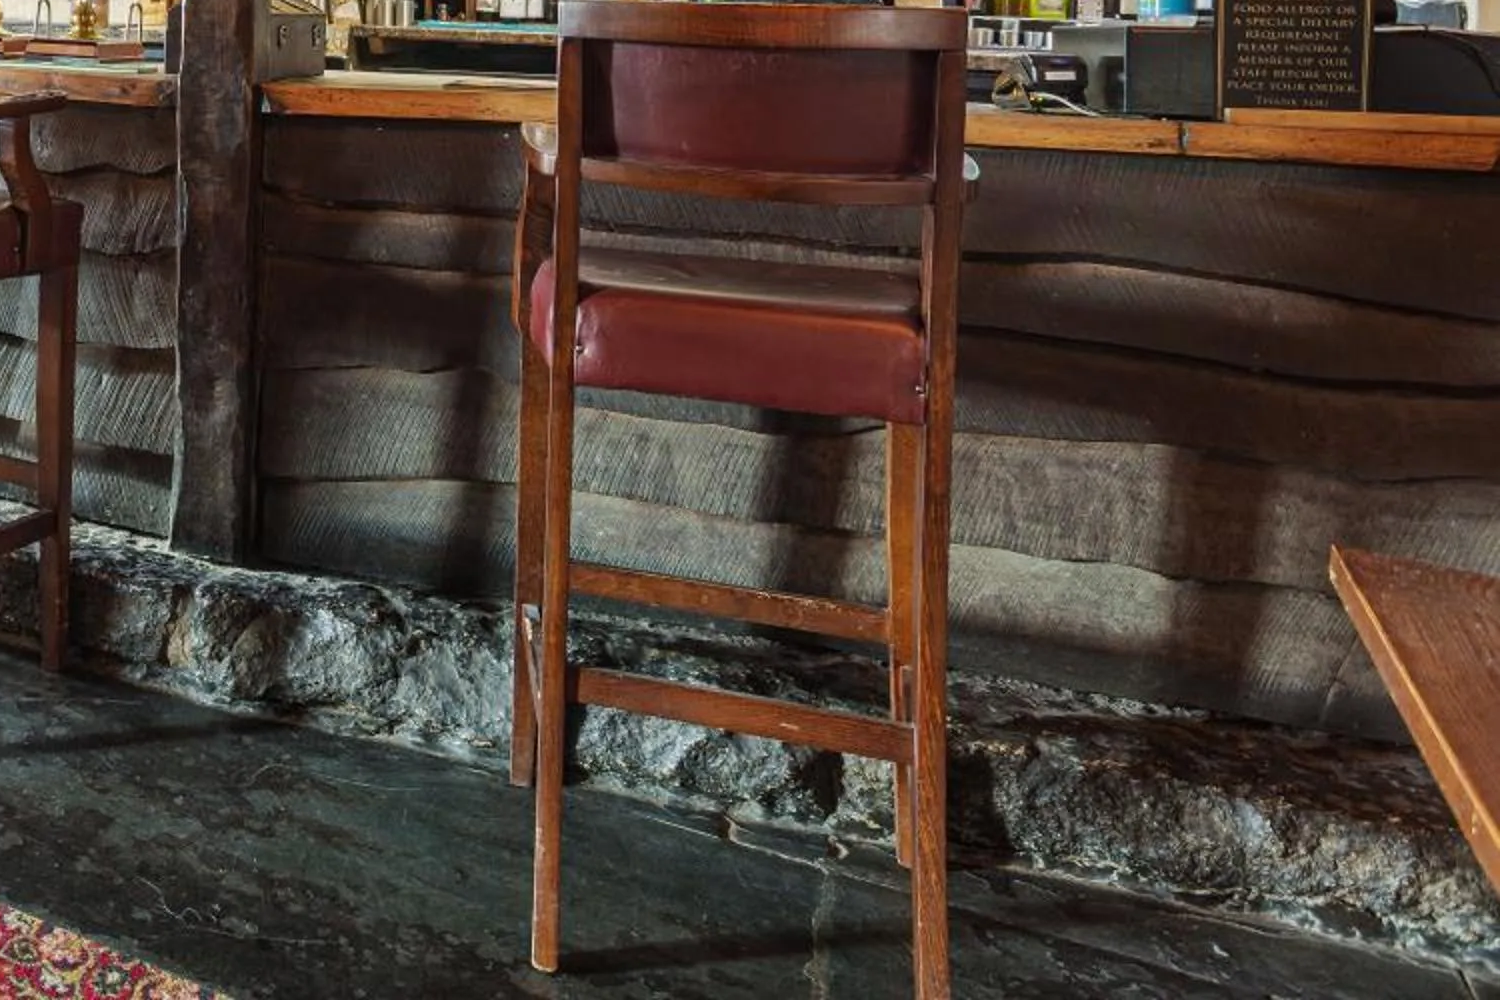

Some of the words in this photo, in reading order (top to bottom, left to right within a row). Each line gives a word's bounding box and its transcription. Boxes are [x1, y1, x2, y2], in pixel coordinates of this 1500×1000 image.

[1233, 3, 1272, 14] FOOD
[1275, 4, 1332, 15] ALLERGY
[1337, 5, 1357, 15] OR
[1246, 17, 1295, 27] SPECIAL
[1300, 18, 1357, 28] DIETARY
[1237, 43, 1279, 53] PLEASE
[1285, 43, 1338, 53] INFORM
[1238, 55, 1294, 66] MEMBER
[1318, 57, 1348, 67] OUR
[1325, 71, 1353, 80] YOU
[1270, 81, 1305, 91] YOUR
